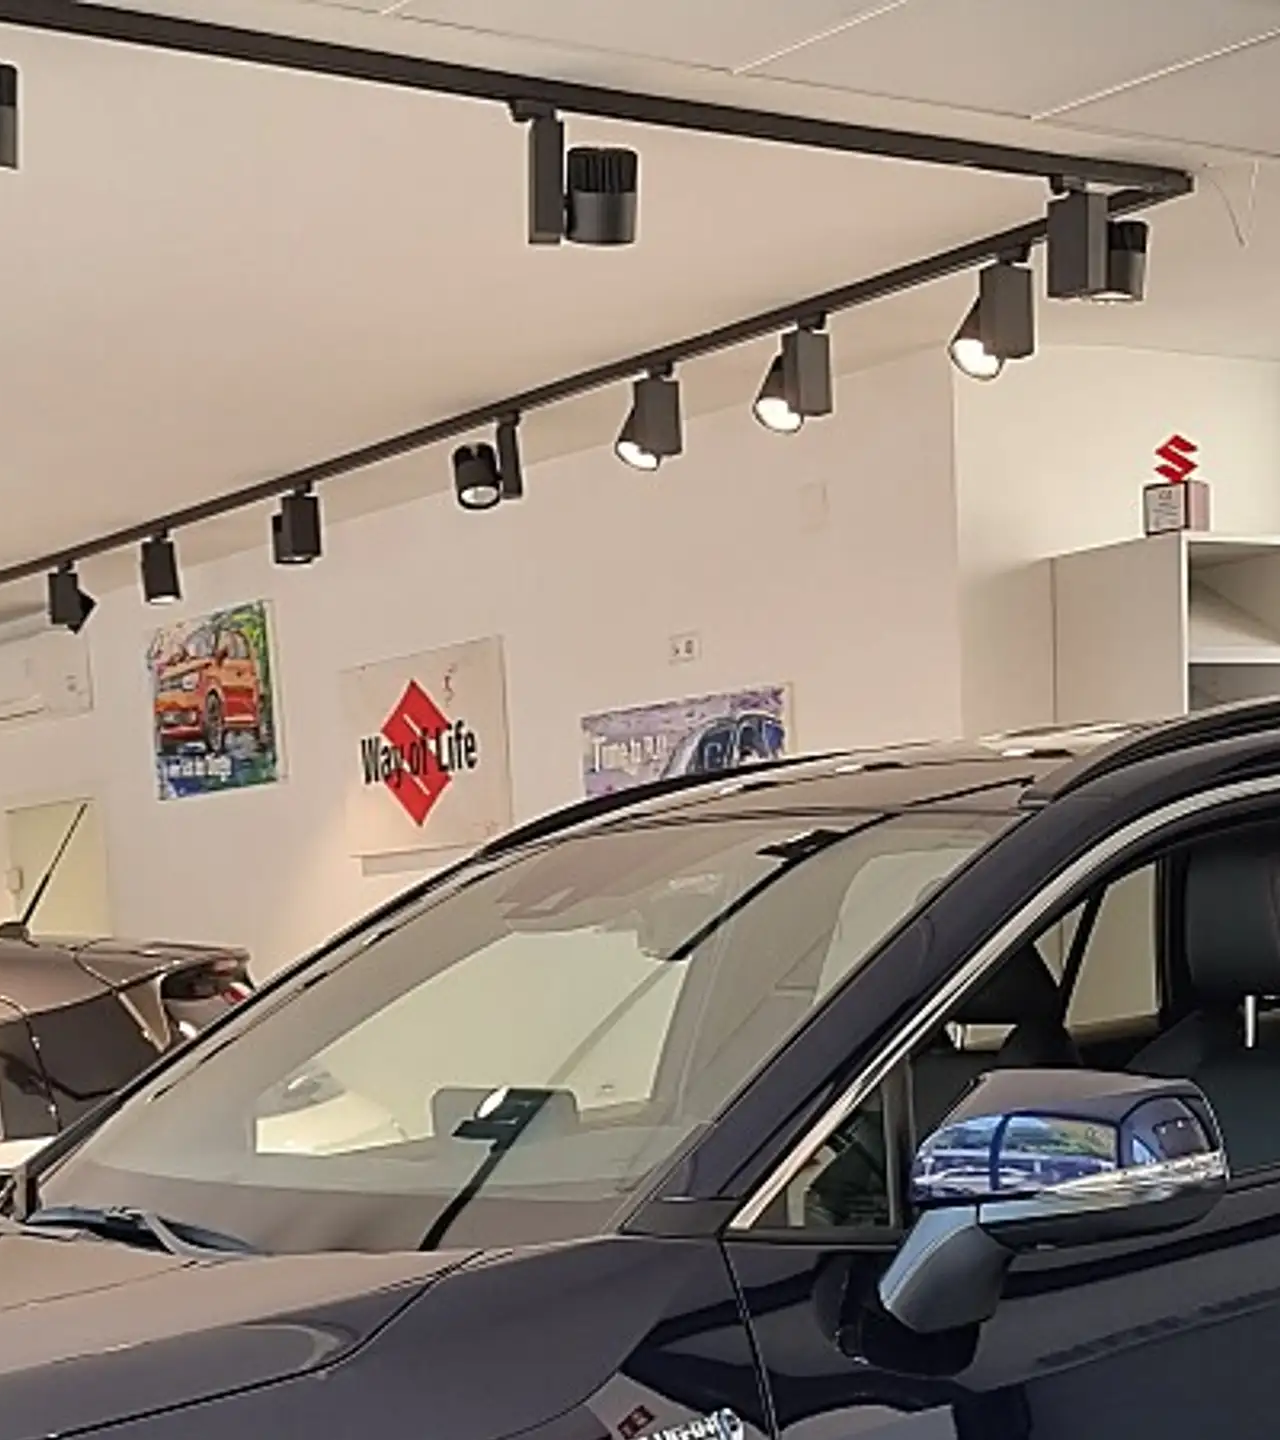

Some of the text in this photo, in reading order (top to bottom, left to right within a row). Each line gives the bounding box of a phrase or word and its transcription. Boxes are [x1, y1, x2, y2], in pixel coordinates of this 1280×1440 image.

[361, 719, 478, 788] Way of Life
